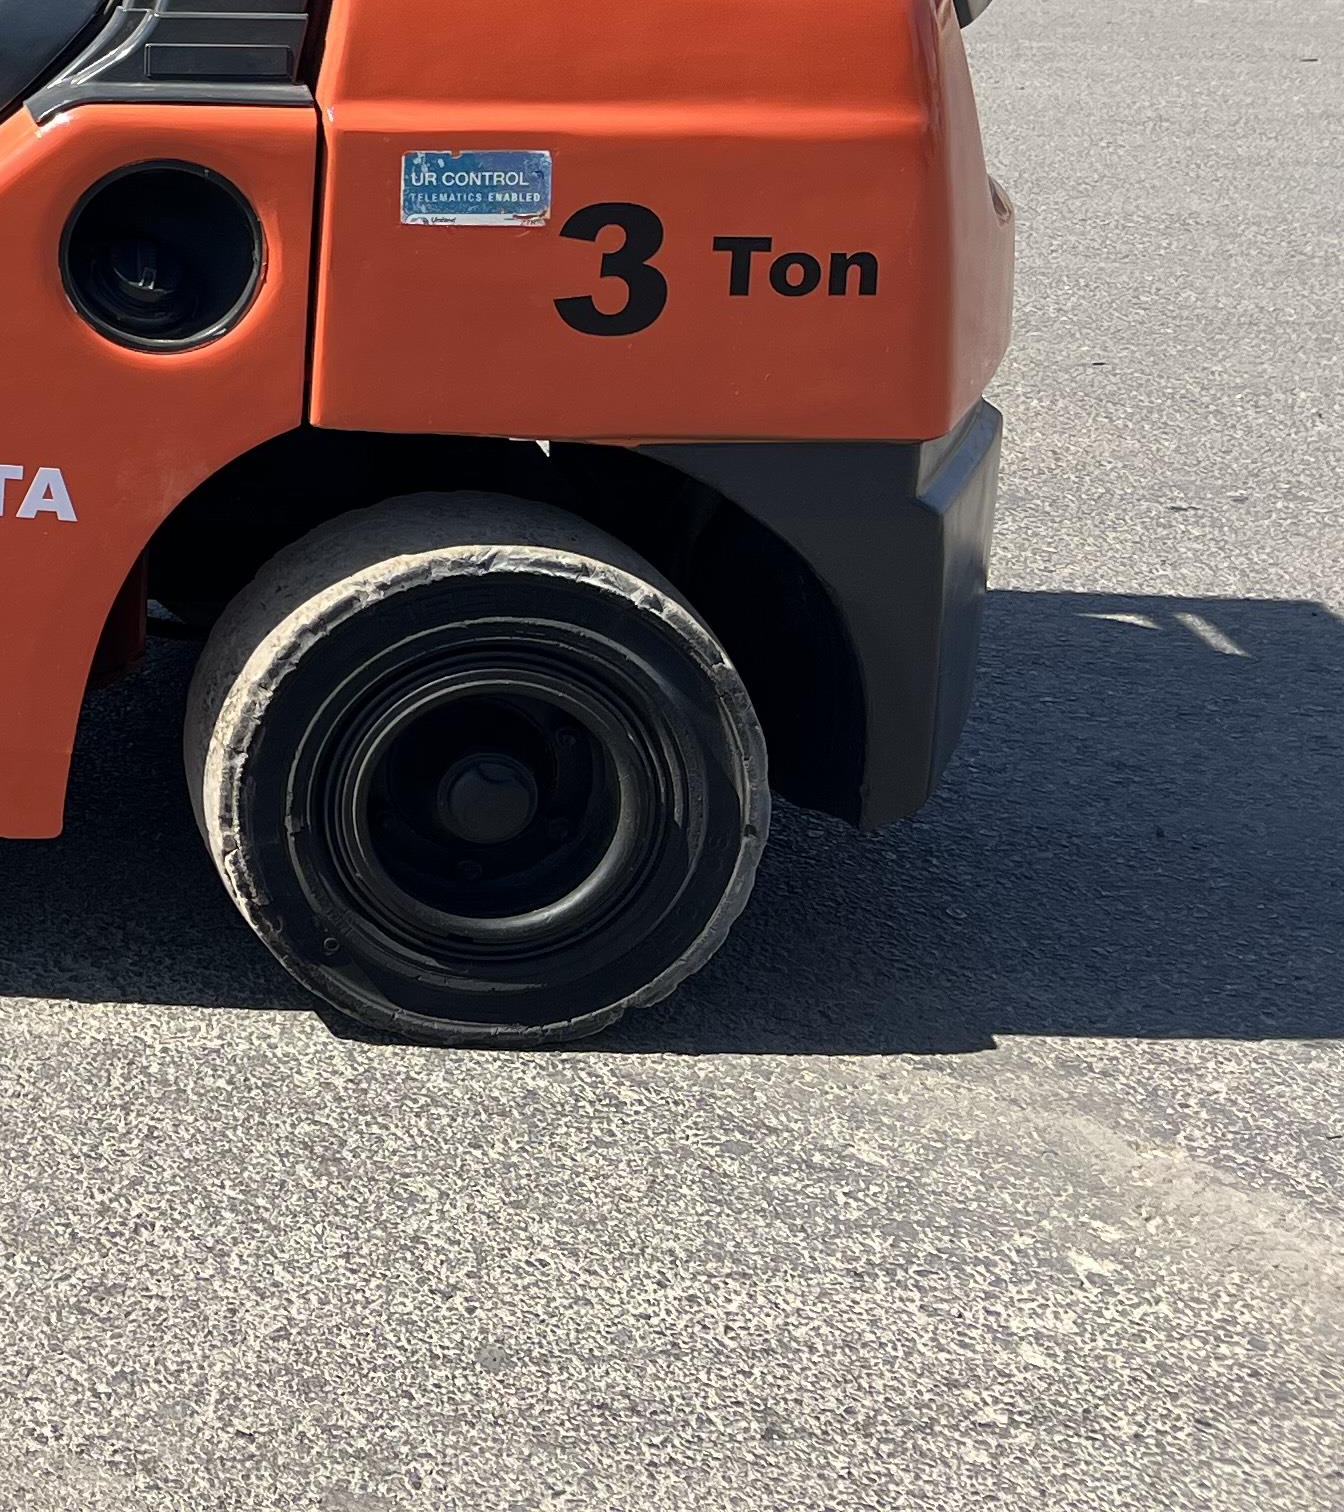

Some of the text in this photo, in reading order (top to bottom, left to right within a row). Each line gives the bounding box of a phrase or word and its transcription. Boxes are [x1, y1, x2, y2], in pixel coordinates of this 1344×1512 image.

[411, 171, 530, 186] UR CONTROL
[410, 192, 541, 203] TELEMATICS ENABLED
[553, 201, 879, 337] 3 Ton
